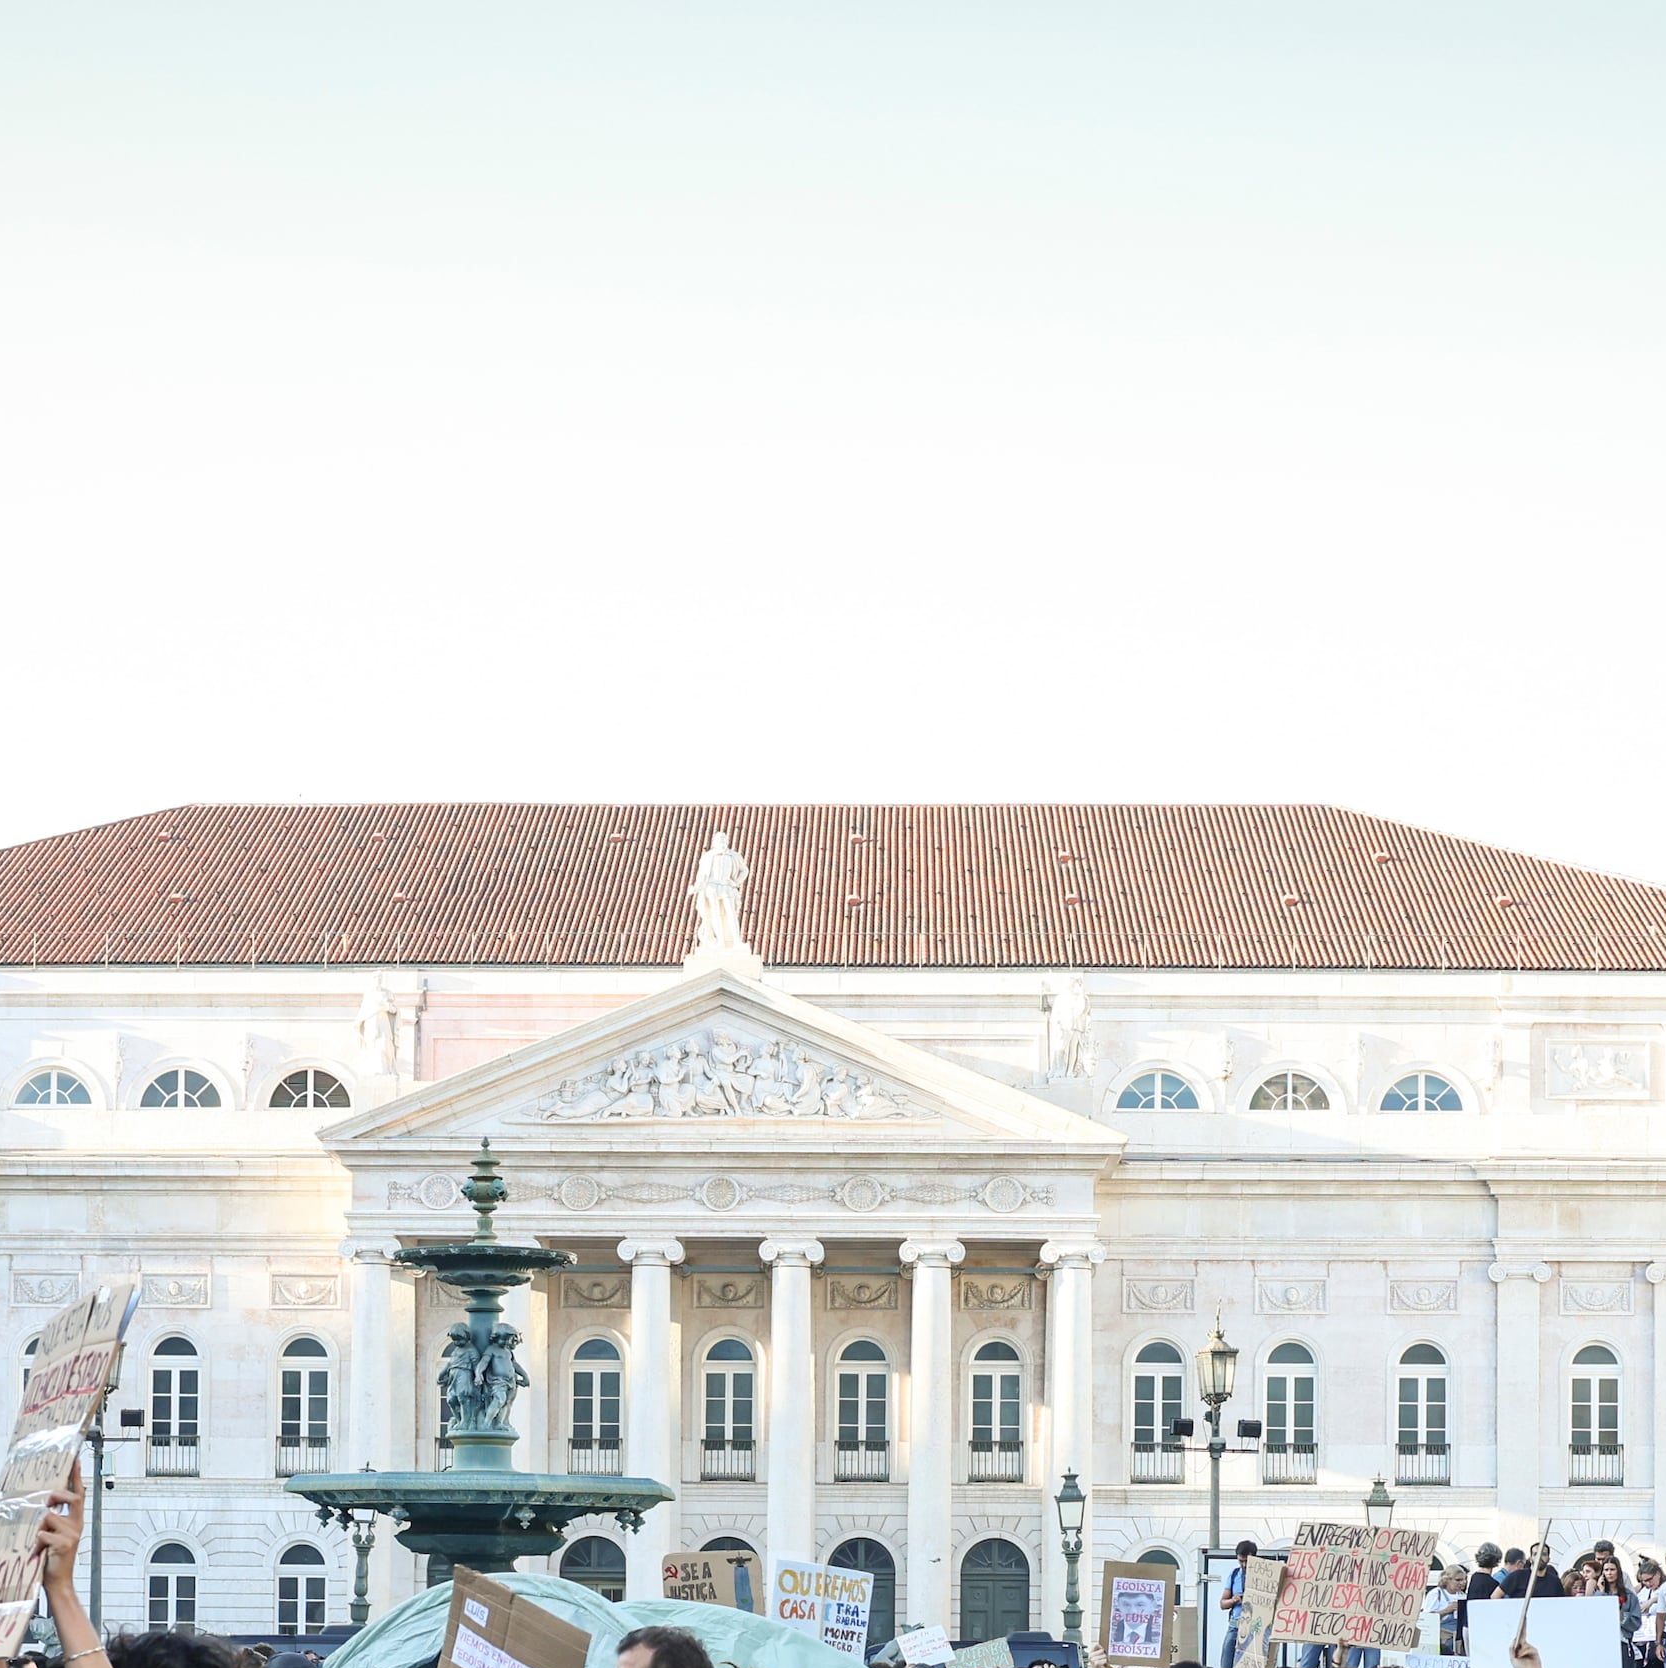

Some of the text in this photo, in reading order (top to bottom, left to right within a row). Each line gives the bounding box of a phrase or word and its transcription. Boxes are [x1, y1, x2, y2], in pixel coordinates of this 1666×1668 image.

[1295, 1523, 1435, 1557] ENTREGAMOS O CRAVO
[680, 1562, 713, 1582] SE A
[778, 1569, 871, 1603] QUEREMOS
[1285, 1551, 1319, 1581] ELES
[1393, 1560, 1428, 1591] CHÃO
[664, 1582, 718, 1601] JUSTIÇA
[1282, 1583, 1298, 1606] O
[1301, 1582, 1334, 1608] POVO
[1363, 1586, 1415, 1617] CANSADO
[779, 1599, 816, 1621] CASA
[835, 1603, 867, 1619] TRA-
[824, 1627, 863, 1643] MONTE
[1274, 1609, 1413, 1647] SEM TECTO SEM SOLUÇÃO
[457, 1631, 489, 1657] VIEMOS
